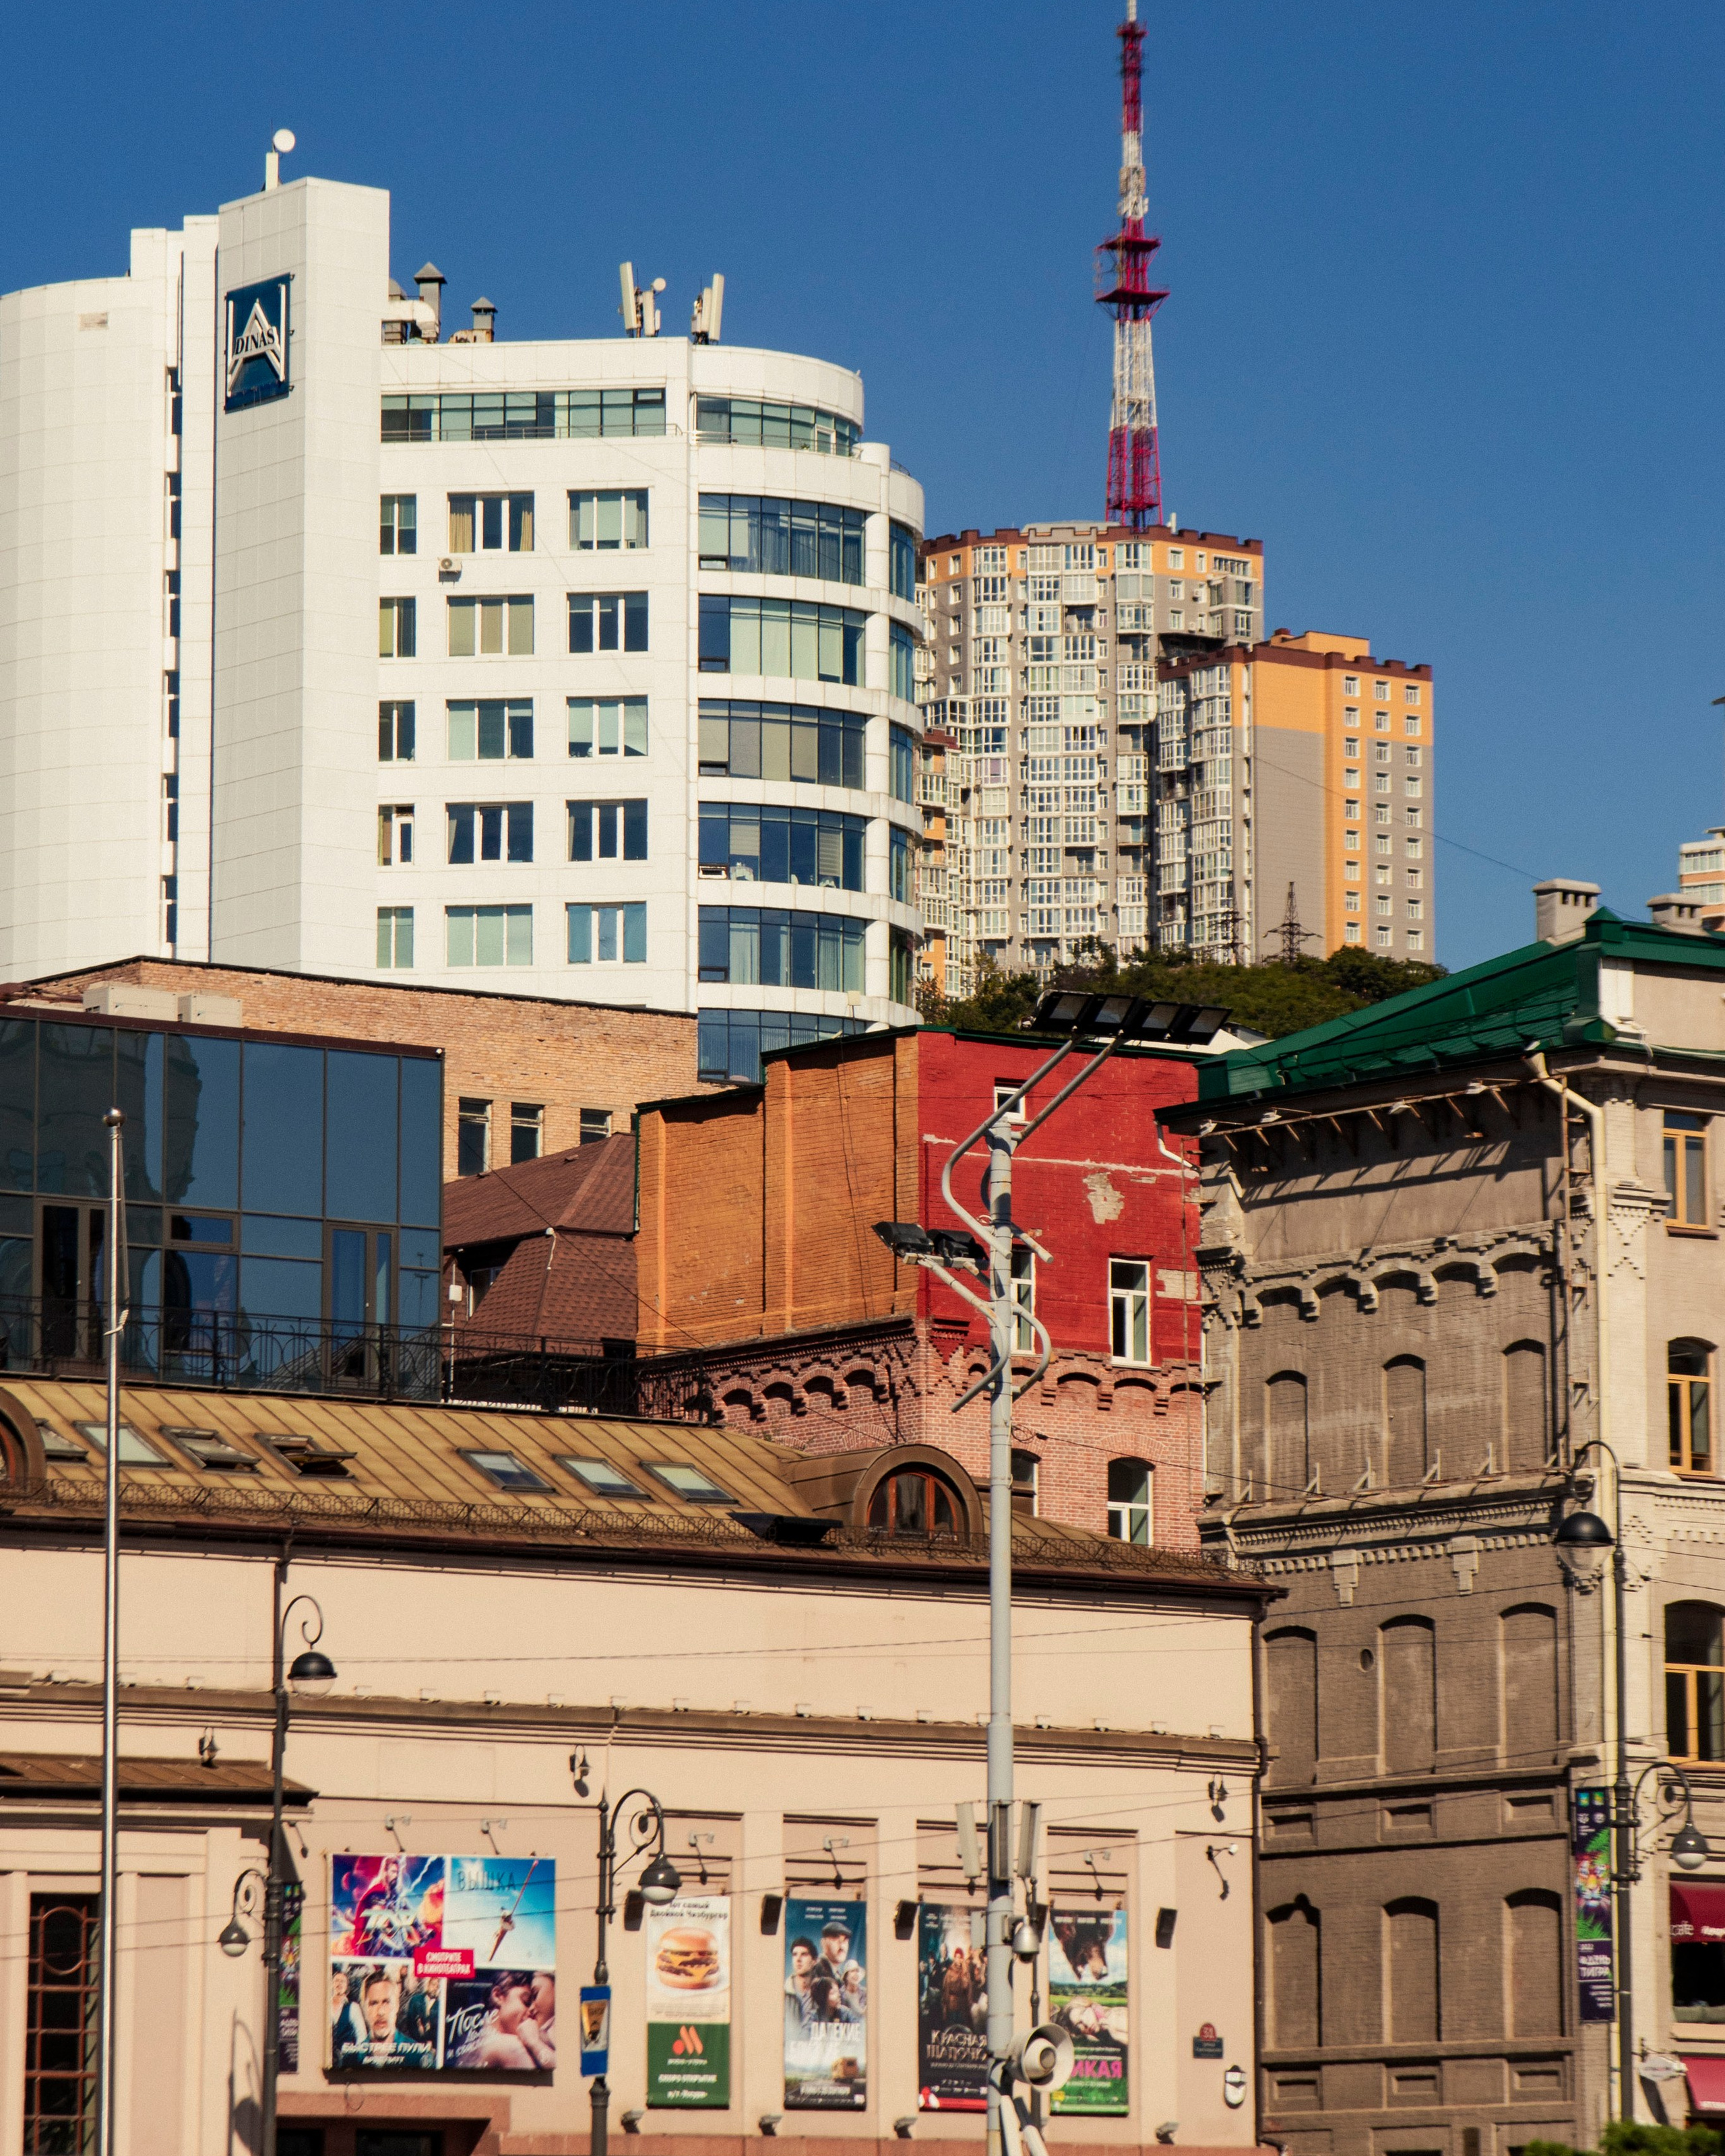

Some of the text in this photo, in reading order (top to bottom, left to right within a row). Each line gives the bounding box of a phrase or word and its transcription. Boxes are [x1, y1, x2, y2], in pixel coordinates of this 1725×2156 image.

[234, 328, 275, 354] DINAS
[458, 1871, 516, 1891] ВЫШКА
[425, 1951, 462, 1963] СМОТРИТЕ
[424, 1963, 470, 1975] КИНОТЕАТРАХ
[445, 2003, 499, 2044] После
[341, 2041, 433, 2054] БЫСТРЕЕ ПУЛИ
[931, 2030, 987, 2048] КРАСНАЯ
